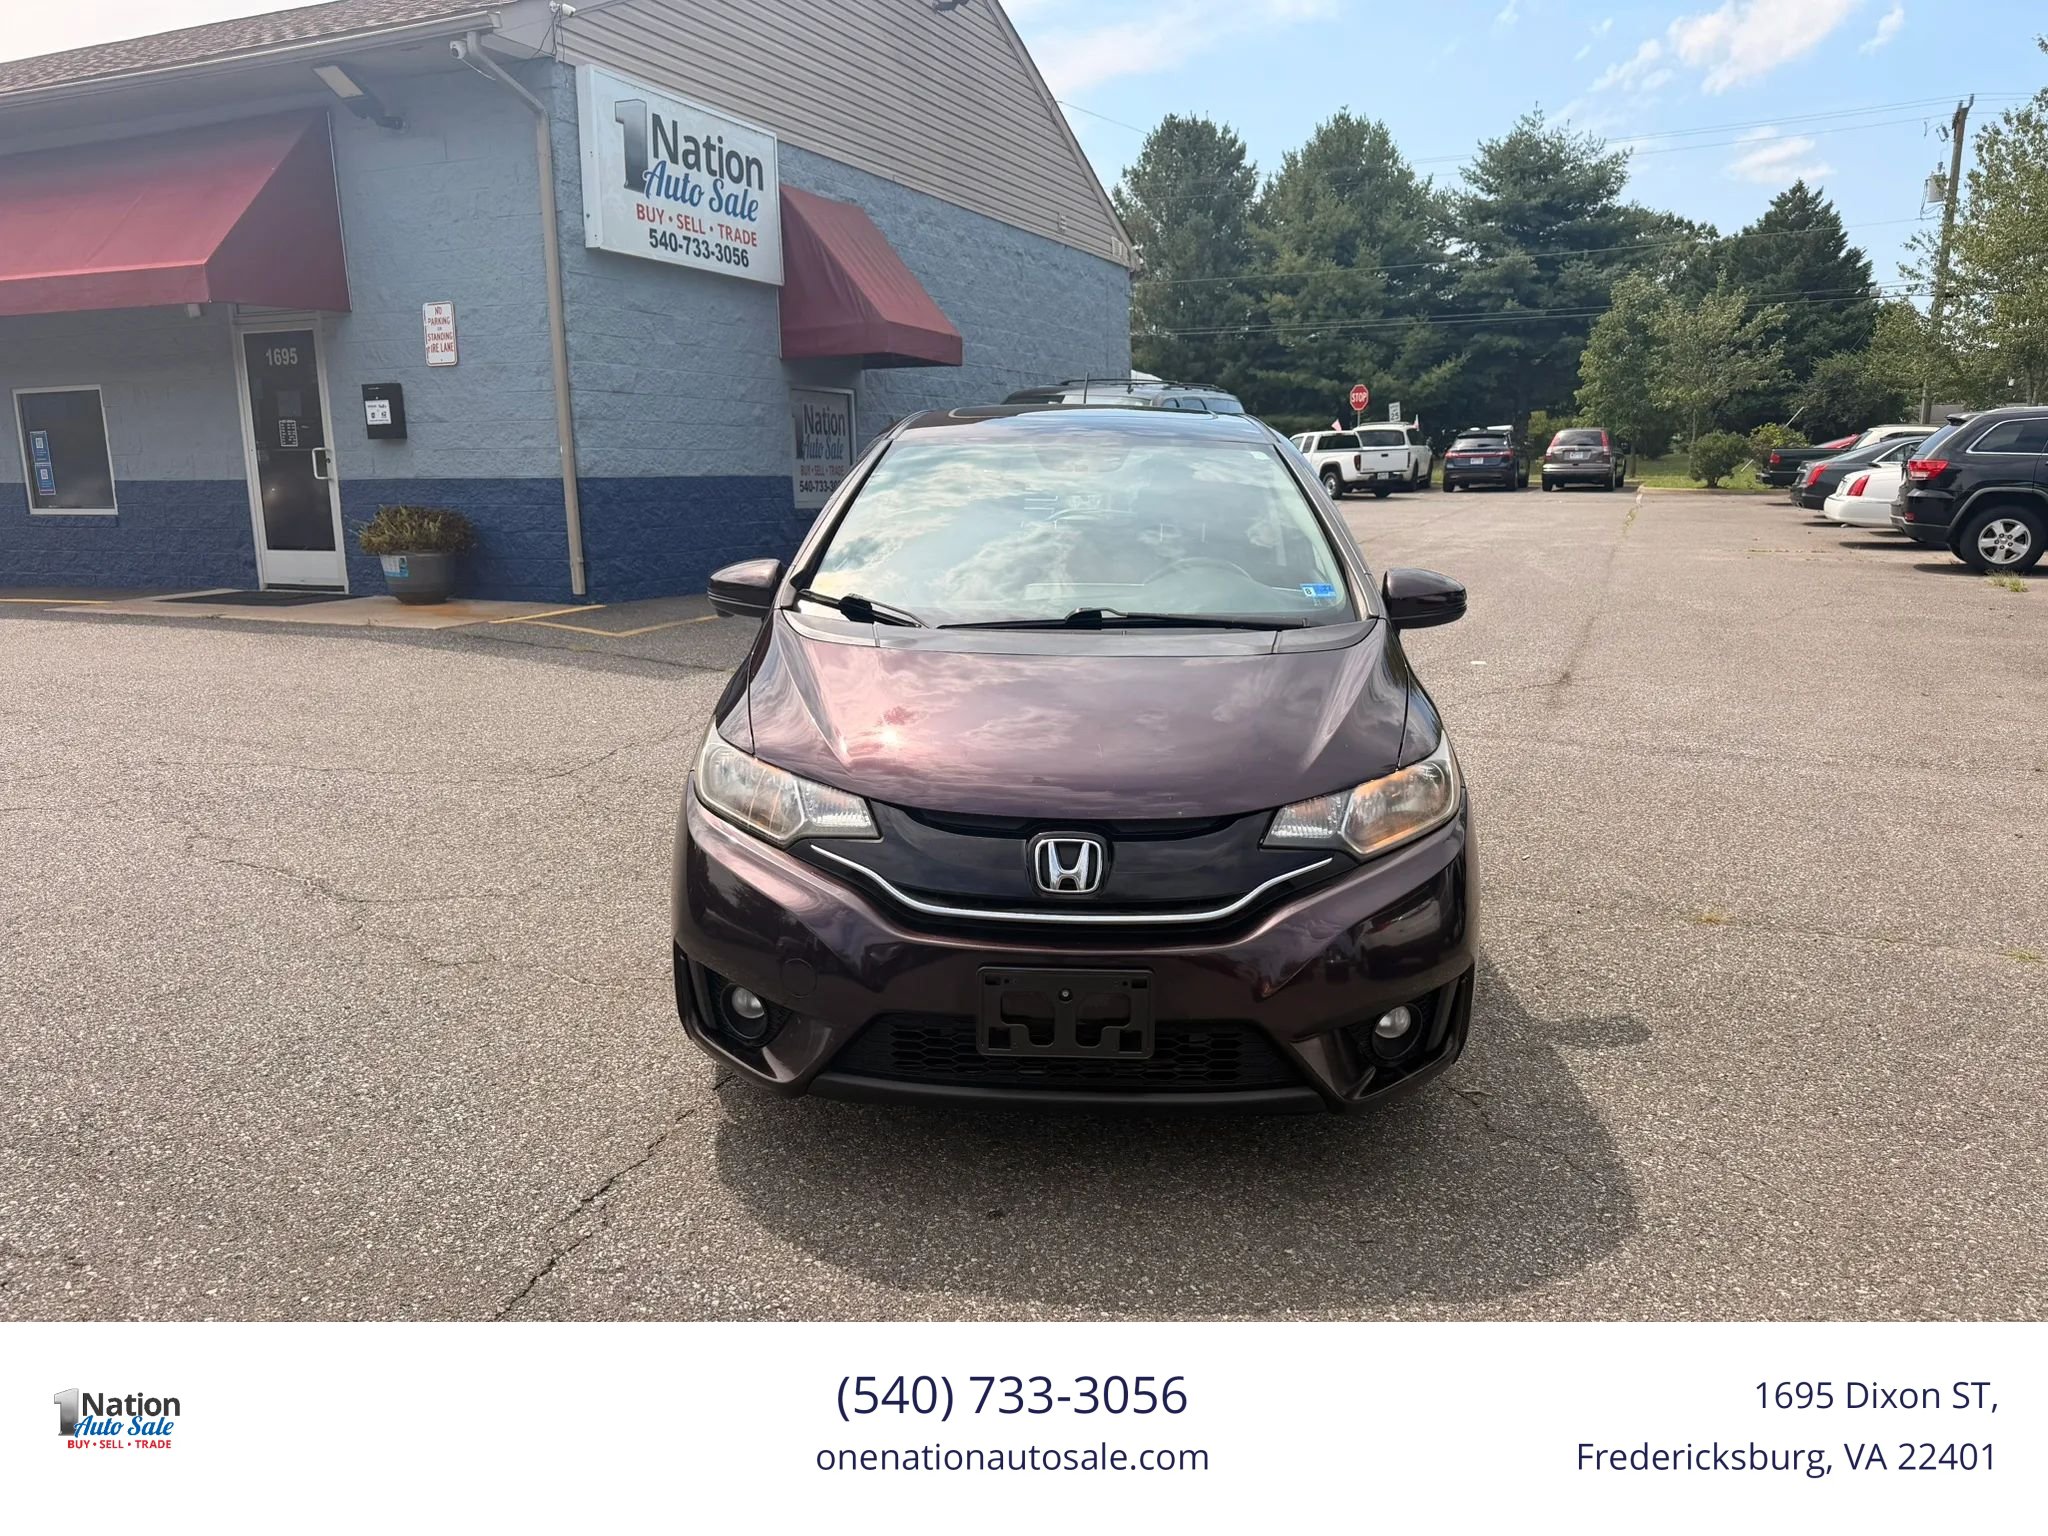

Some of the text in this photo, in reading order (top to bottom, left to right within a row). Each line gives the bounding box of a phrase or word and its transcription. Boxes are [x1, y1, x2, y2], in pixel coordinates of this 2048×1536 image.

[652, 113, 764, 191] Nation
[643, 160, 759, 222] Auto Sale
[636, 203, 758, 247] BUY SELL TRADE
[649, 228, 750, 268] 540-733-3056
[435, 306, 443, 315] NO
[428, 316, 450, 326] PARKING
[428, 332, 453, 341] STANDING
[441, 343, 454, 352] LANE
[265, 347, 299, 367] 1695
[1351, 391, 1367, 403] STOP
[804, 404, 846, 436] Nation
[801, 434, 844, 460] Auto Sale
[800, 465, 845, 476] BUY SELL TRADE
[800, 479, 842, 493] 540-733-30
